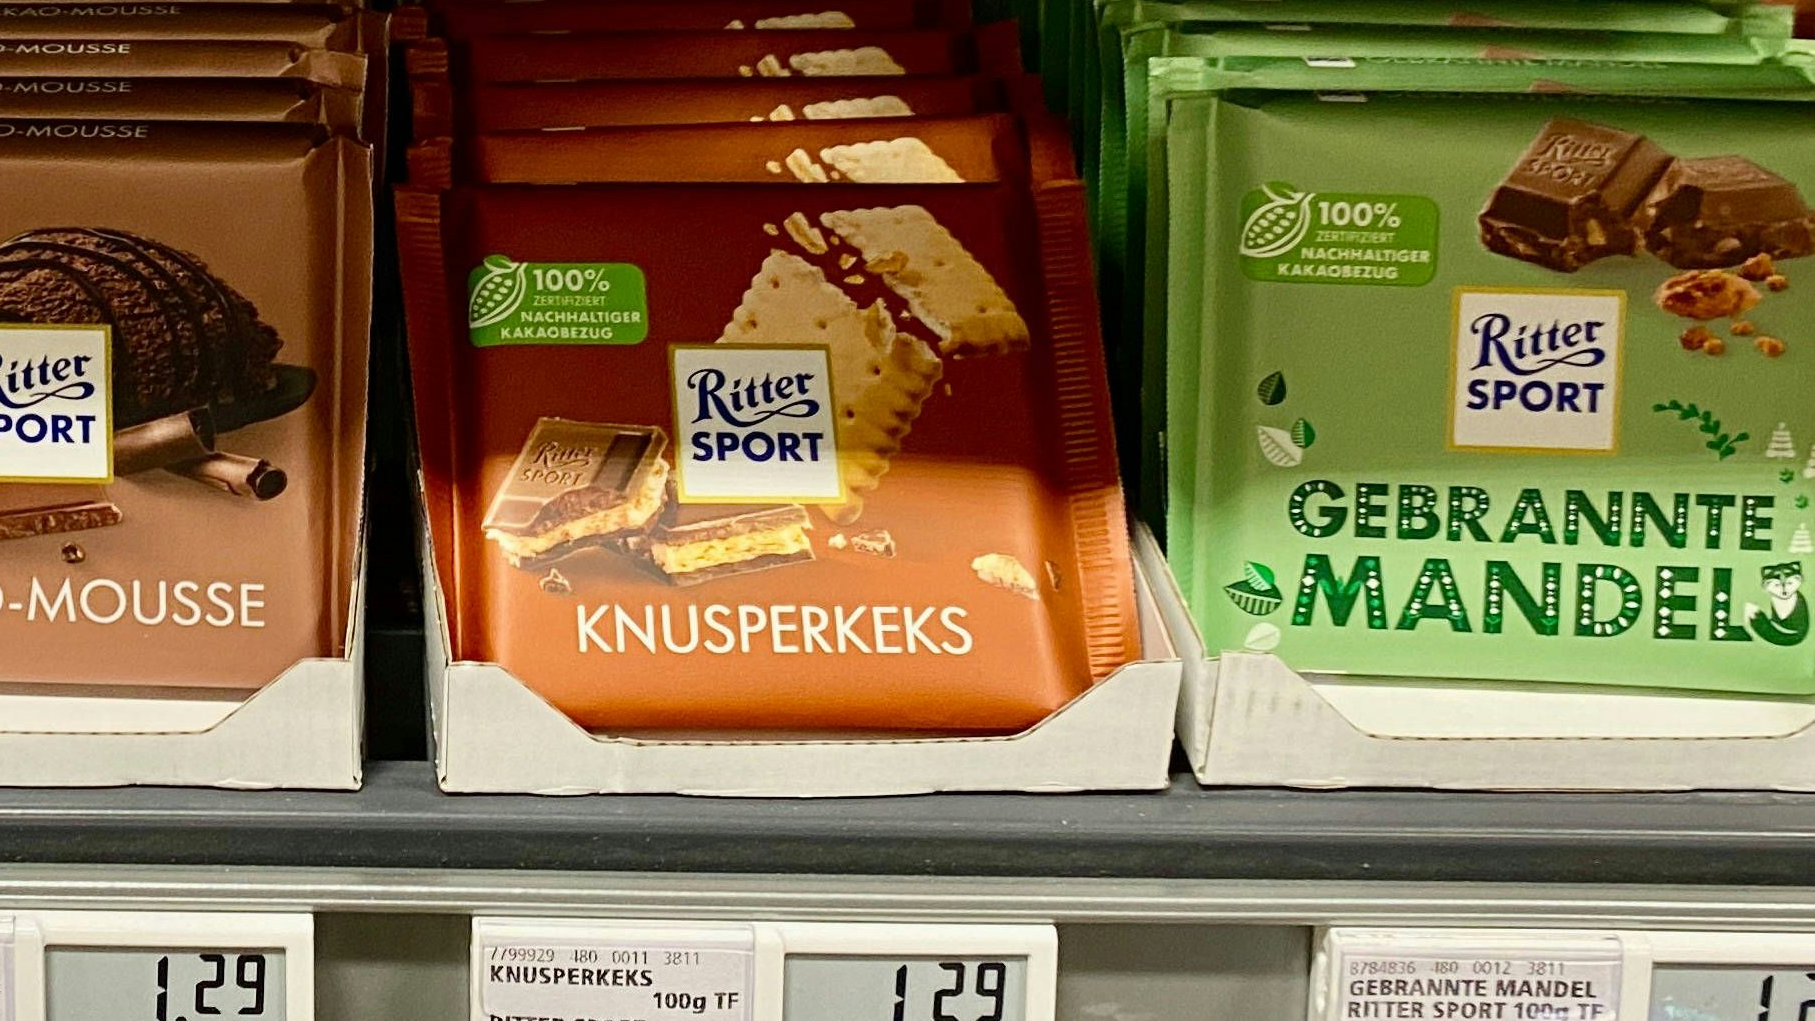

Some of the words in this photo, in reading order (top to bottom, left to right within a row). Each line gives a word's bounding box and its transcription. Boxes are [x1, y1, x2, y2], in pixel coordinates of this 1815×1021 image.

[1318, 201, 1401, 229] 100%
[1301, 247, 1430, 263] NACHHALTIGER
[533, 269, 610, 293] 100%
[1278, 264, 1398, 280] KAKAOBEZUG
[521, 311, 641, 324] NACHHALTIGER
[500, 326, 613, 339] KAKAOBEZUG
[1470, 313, 1604, 376] Ritter
[688, 367, 819, 427] Ritter
[1466, 380, 1604, 413] SPORT
[692, 431, 823, 462] SPORT
[1288, 480, 1775, 551] GEBRANNTE
[1292, 554, 1752, 642] MANDEL
[578, 604, 973, 656] KNUSPERKEKS
[491, 966, 653, 986] KNUSPERKEKS
[1350, 980, 1486, 996] GEBRANNTE
[1496, 980, 1596, 998] MANDEL
[653, 992, 705, 1013] 100g
[714, 993, 739, 1009] TF
[1348, 1002, 1423, 1018] RITTER
[1435, 1002, 1506, 1019] SPORT
